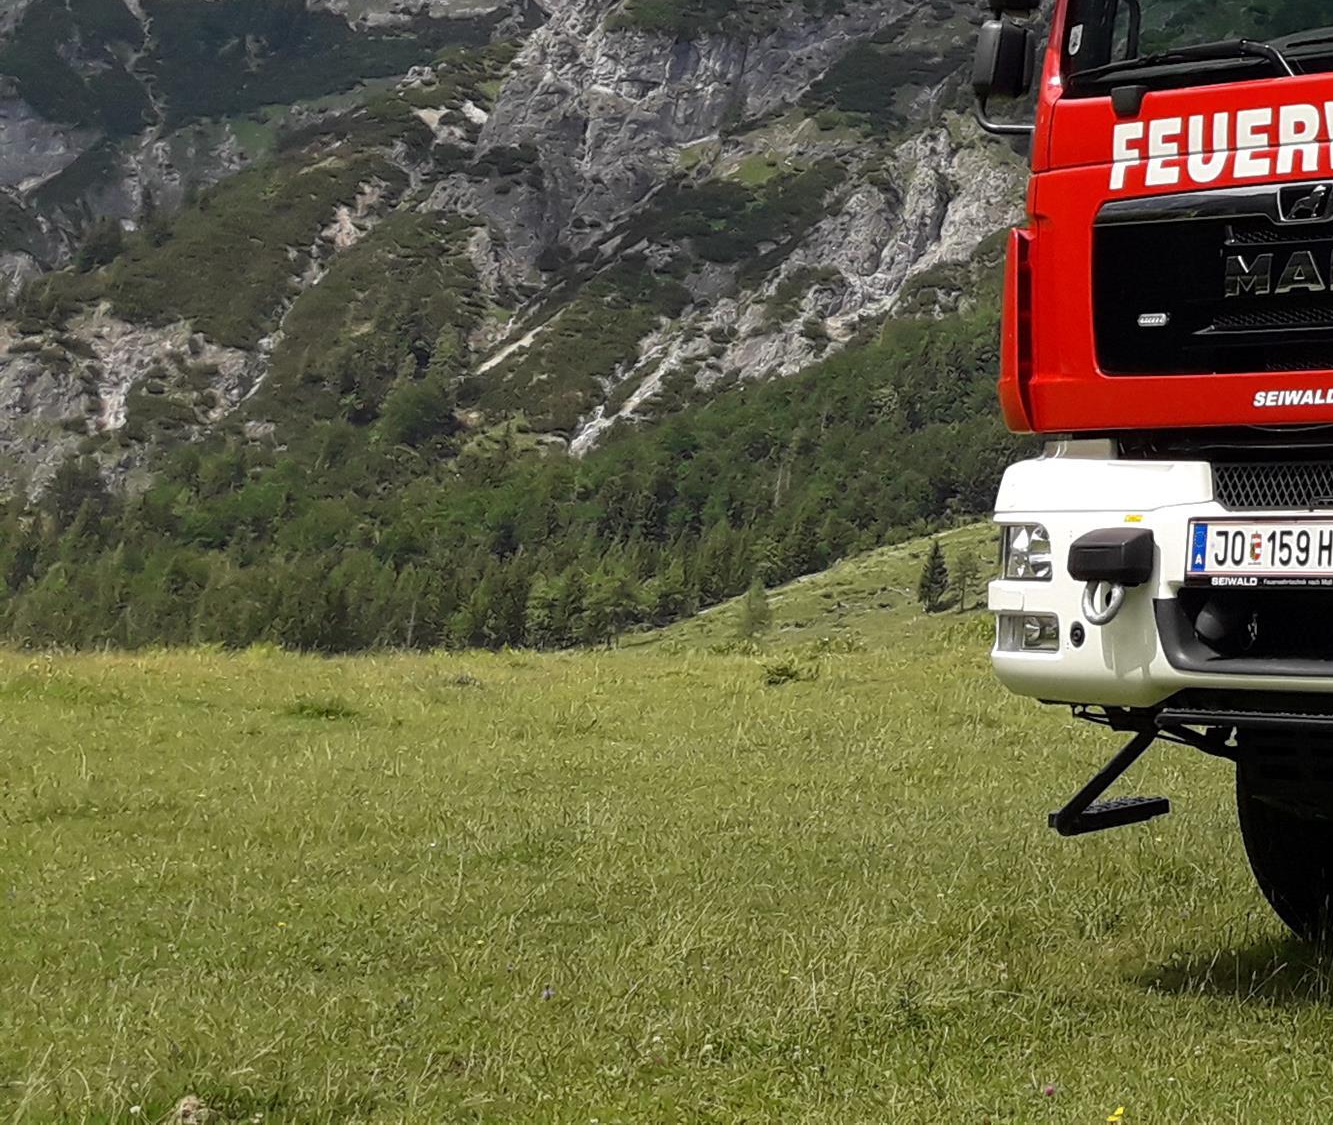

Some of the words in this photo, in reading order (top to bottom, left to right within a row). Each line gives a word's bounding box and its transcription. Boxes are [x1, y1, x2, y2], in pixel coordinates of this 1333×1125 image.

[1214, 530, 1246, 567] JO
[1266, 530, 1311, 567] 159
[1194, 554, 1203, 565] A
[1211, 577, 1258, 586] SEIWALD
